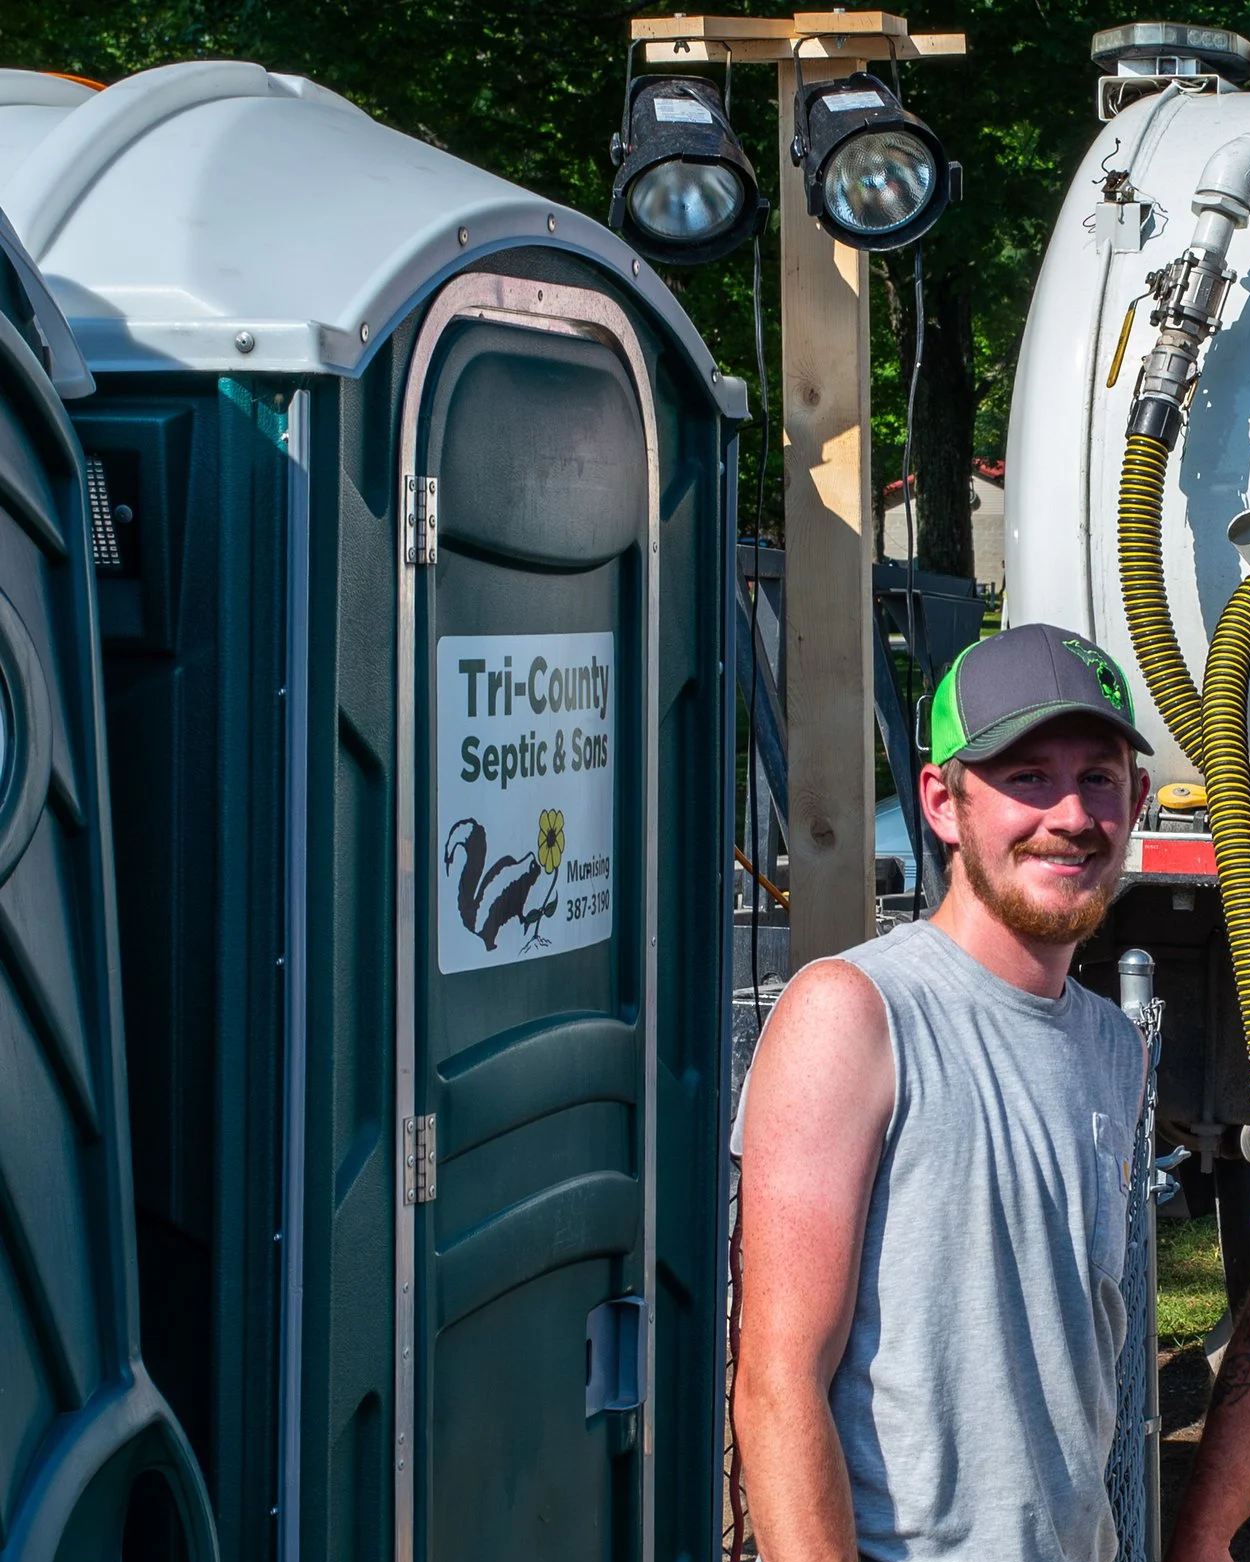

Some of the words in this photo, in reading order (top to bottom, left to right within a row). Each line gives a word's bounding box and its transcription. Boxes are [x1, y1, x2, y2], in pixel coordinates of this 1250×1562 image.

[458, 655, 609, 720] Tri-County
[460, 731, 547, 790] Septic
[552, 729, 566, 774] &
[571, 727, 608, 772] Sons
[566, 857, 610, 884] Munising
[566, 889, 610, 922] 387-3190
